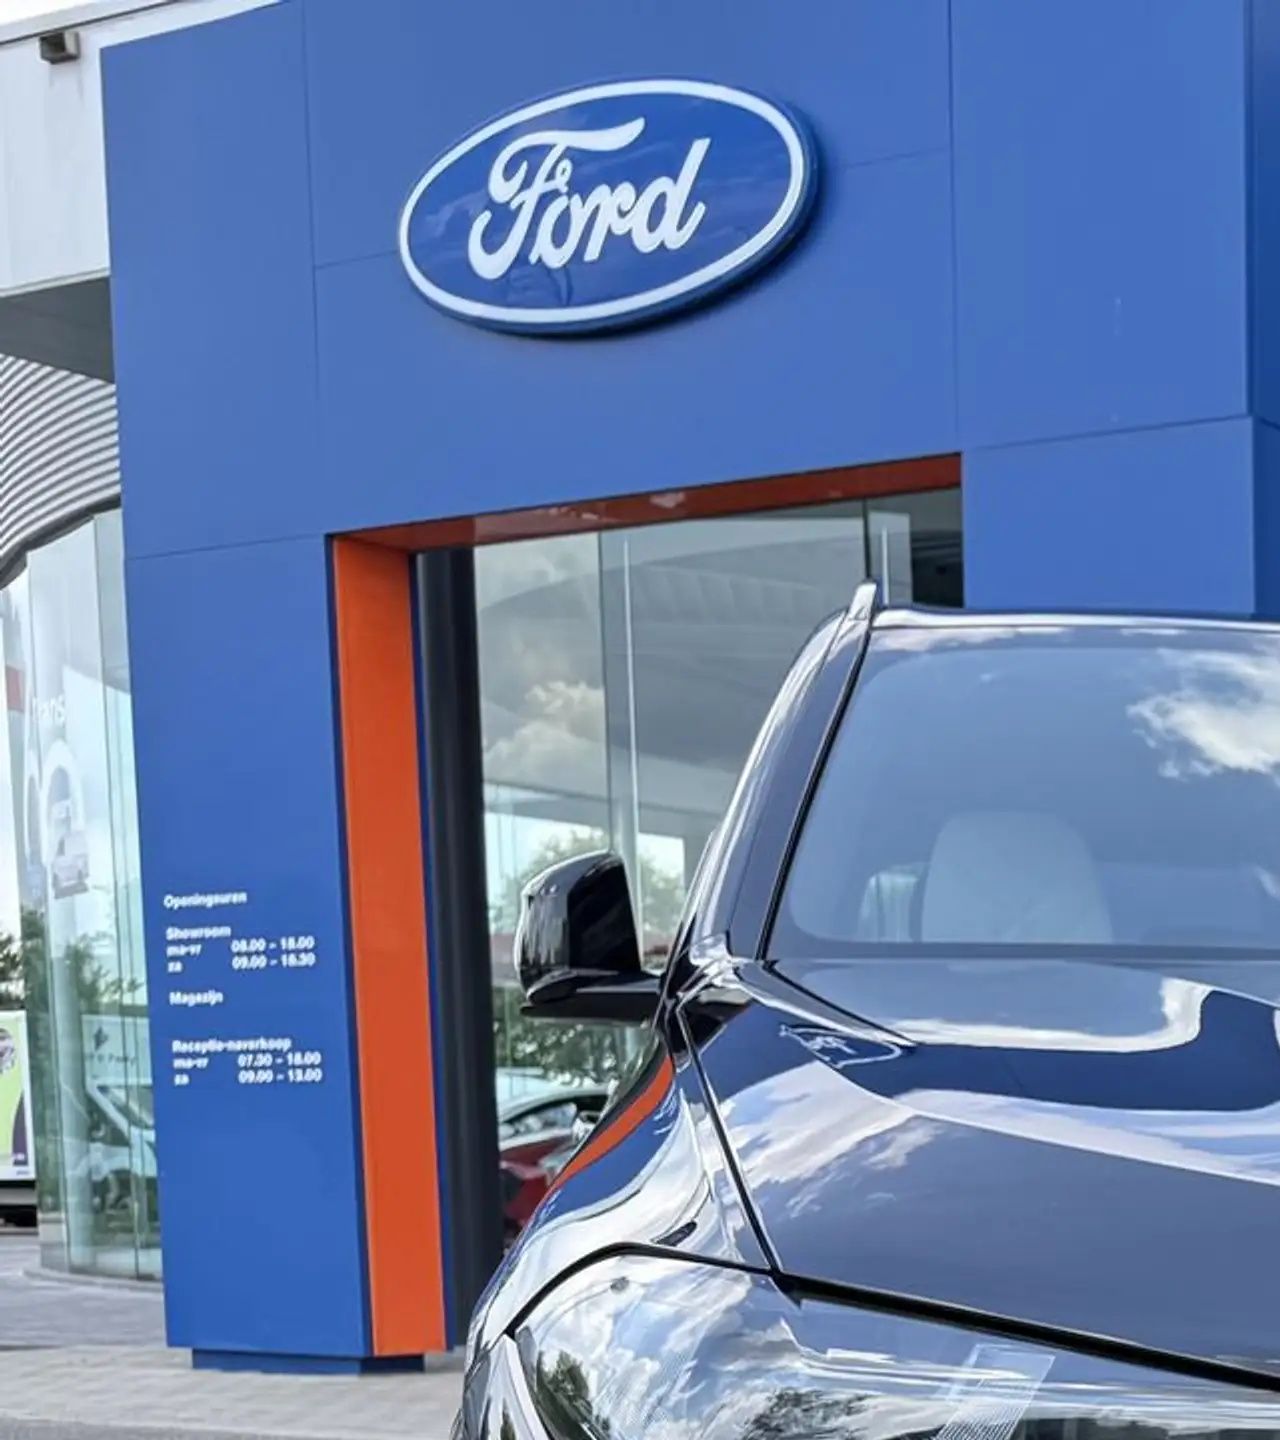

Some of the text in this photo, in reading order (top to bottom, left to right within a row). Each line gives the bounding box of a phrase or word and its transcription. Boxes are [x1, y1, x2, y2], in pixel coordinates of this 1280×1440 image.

[468, 117, 711, 280] Ford
[166, 926, 231, 941] Showroom
[169, 990, 224, 1007] Magazijn
